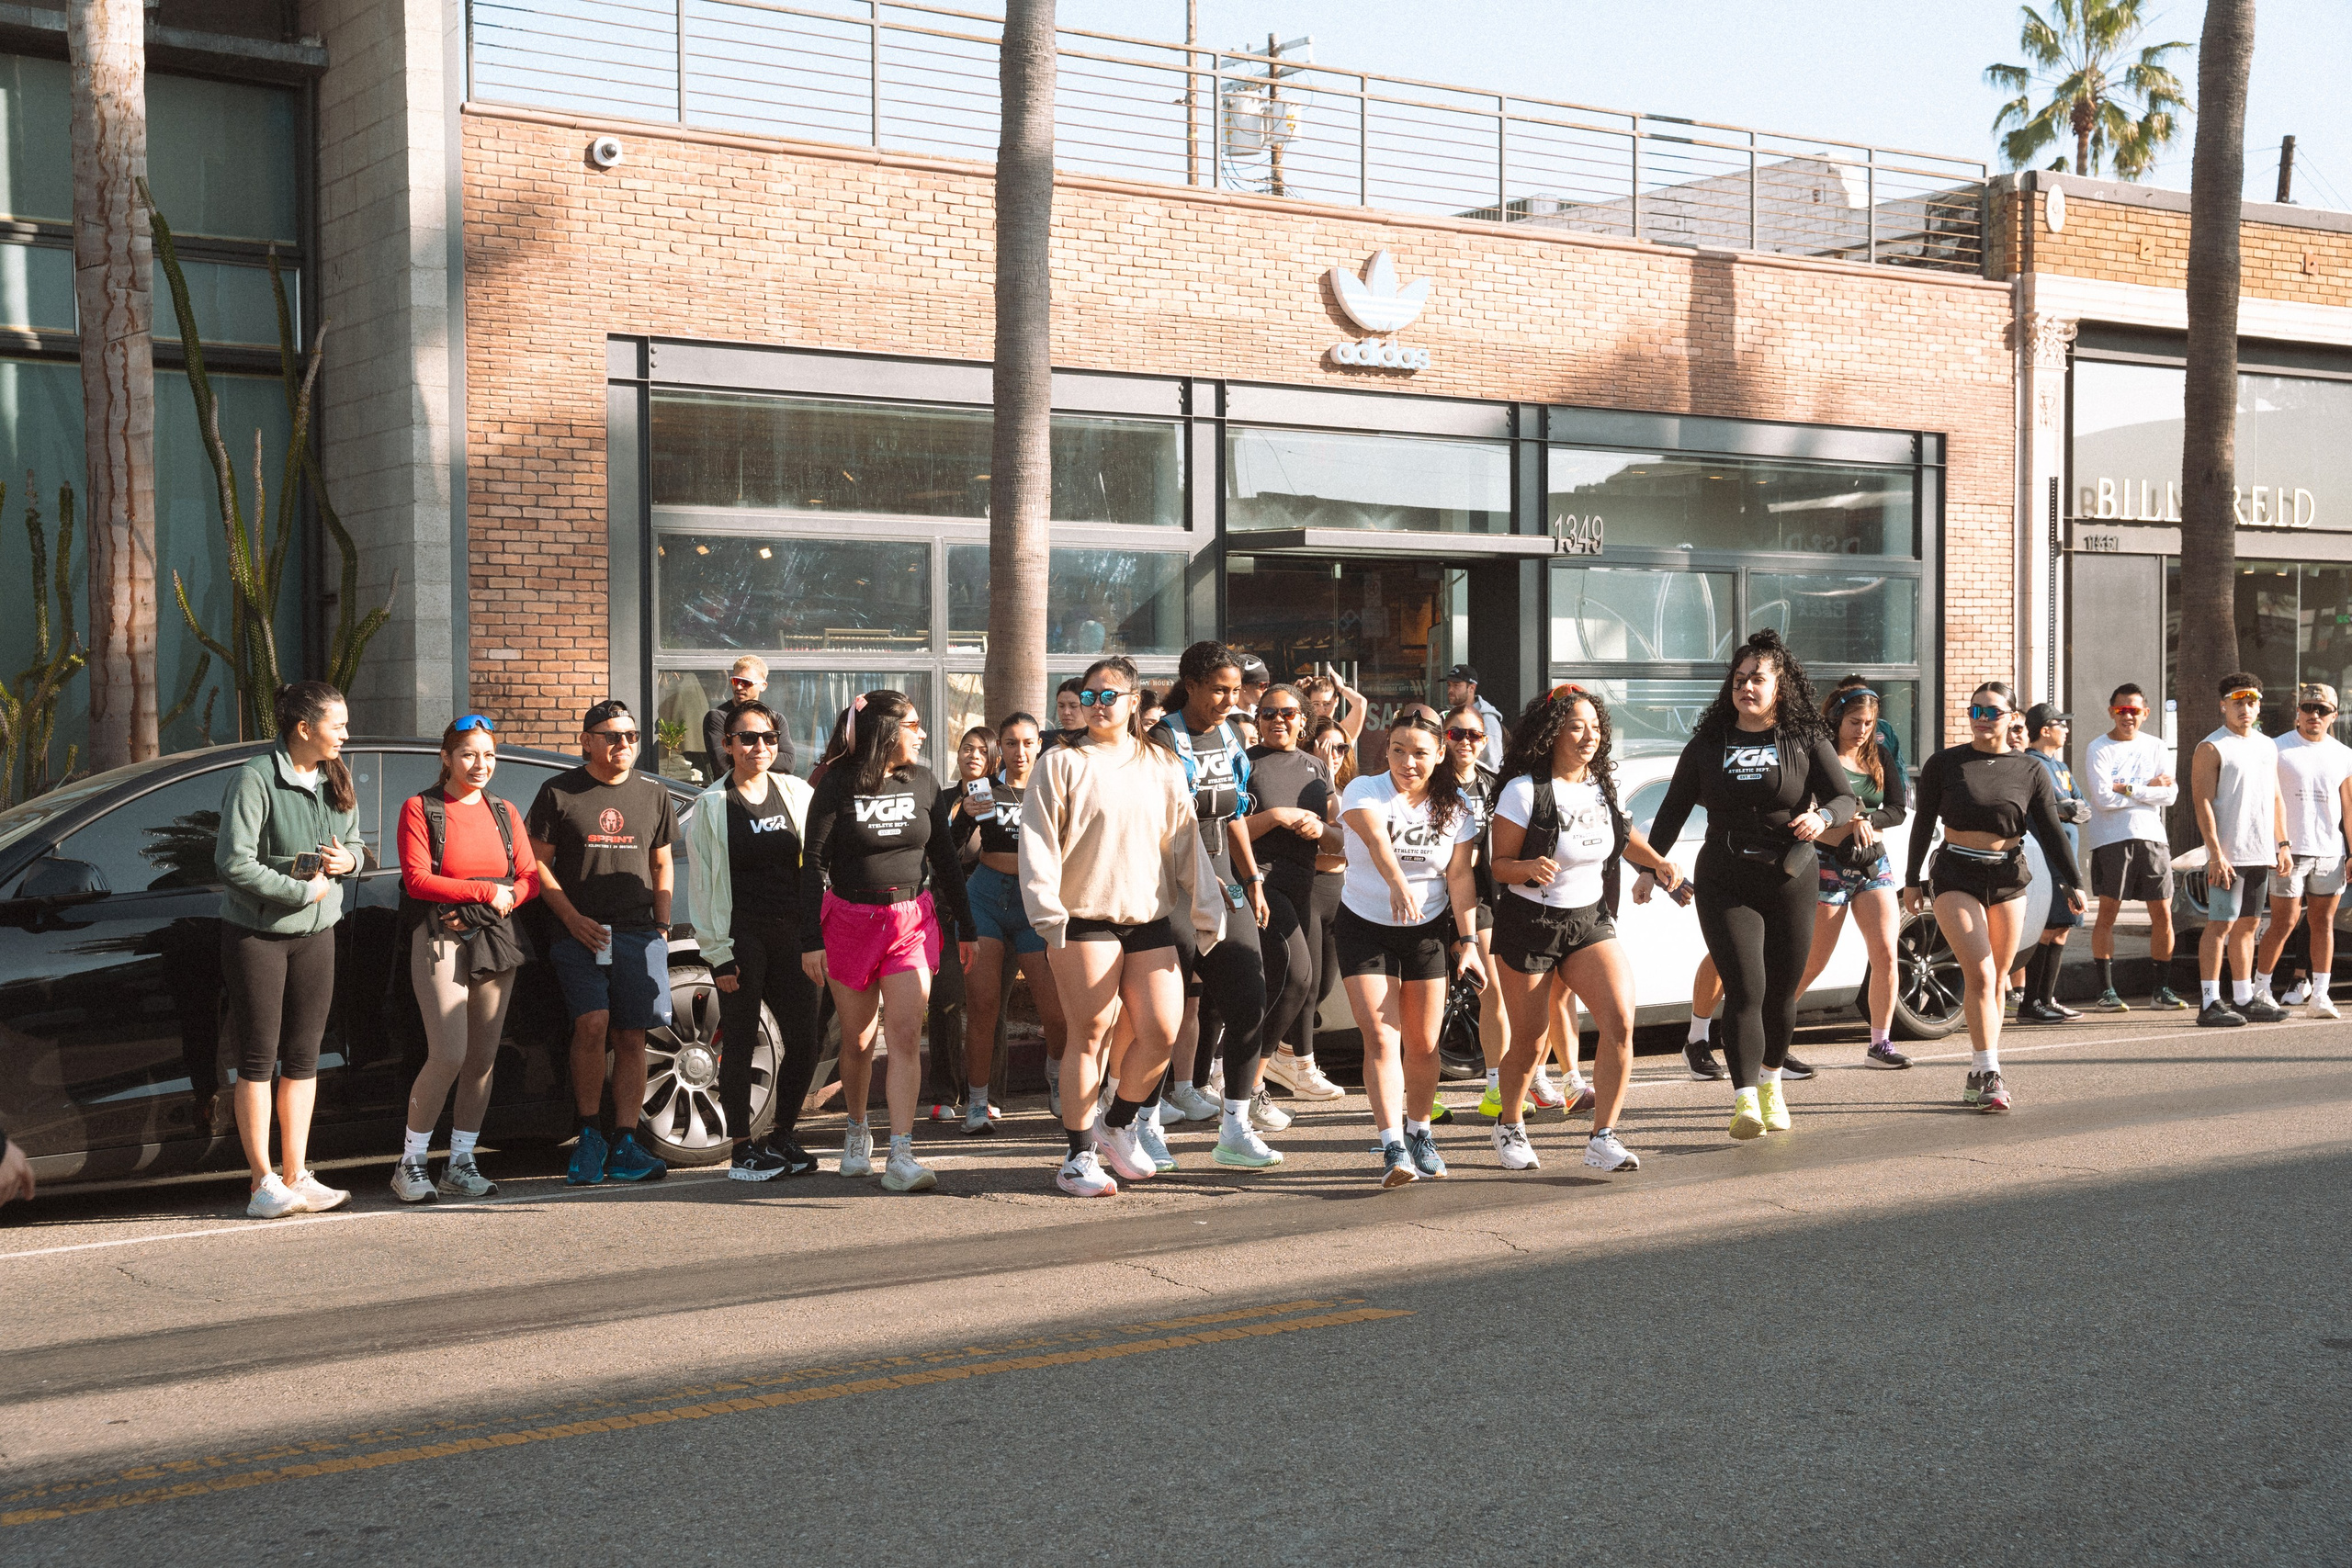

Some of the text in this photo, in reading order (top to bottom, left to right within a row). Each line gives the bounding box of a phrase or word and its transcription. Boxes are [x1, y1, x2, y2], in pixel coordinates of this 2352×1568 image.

[1331, 337, 1431, 370] adidas
[1554, 513, 1603, 554] 1349
[1365, 703, 1403, 731] SA
[854, 796, 917, 822] VGR
[749, 815, 788, 834] VGR
[588, 834, 634, 843] SPRINT
